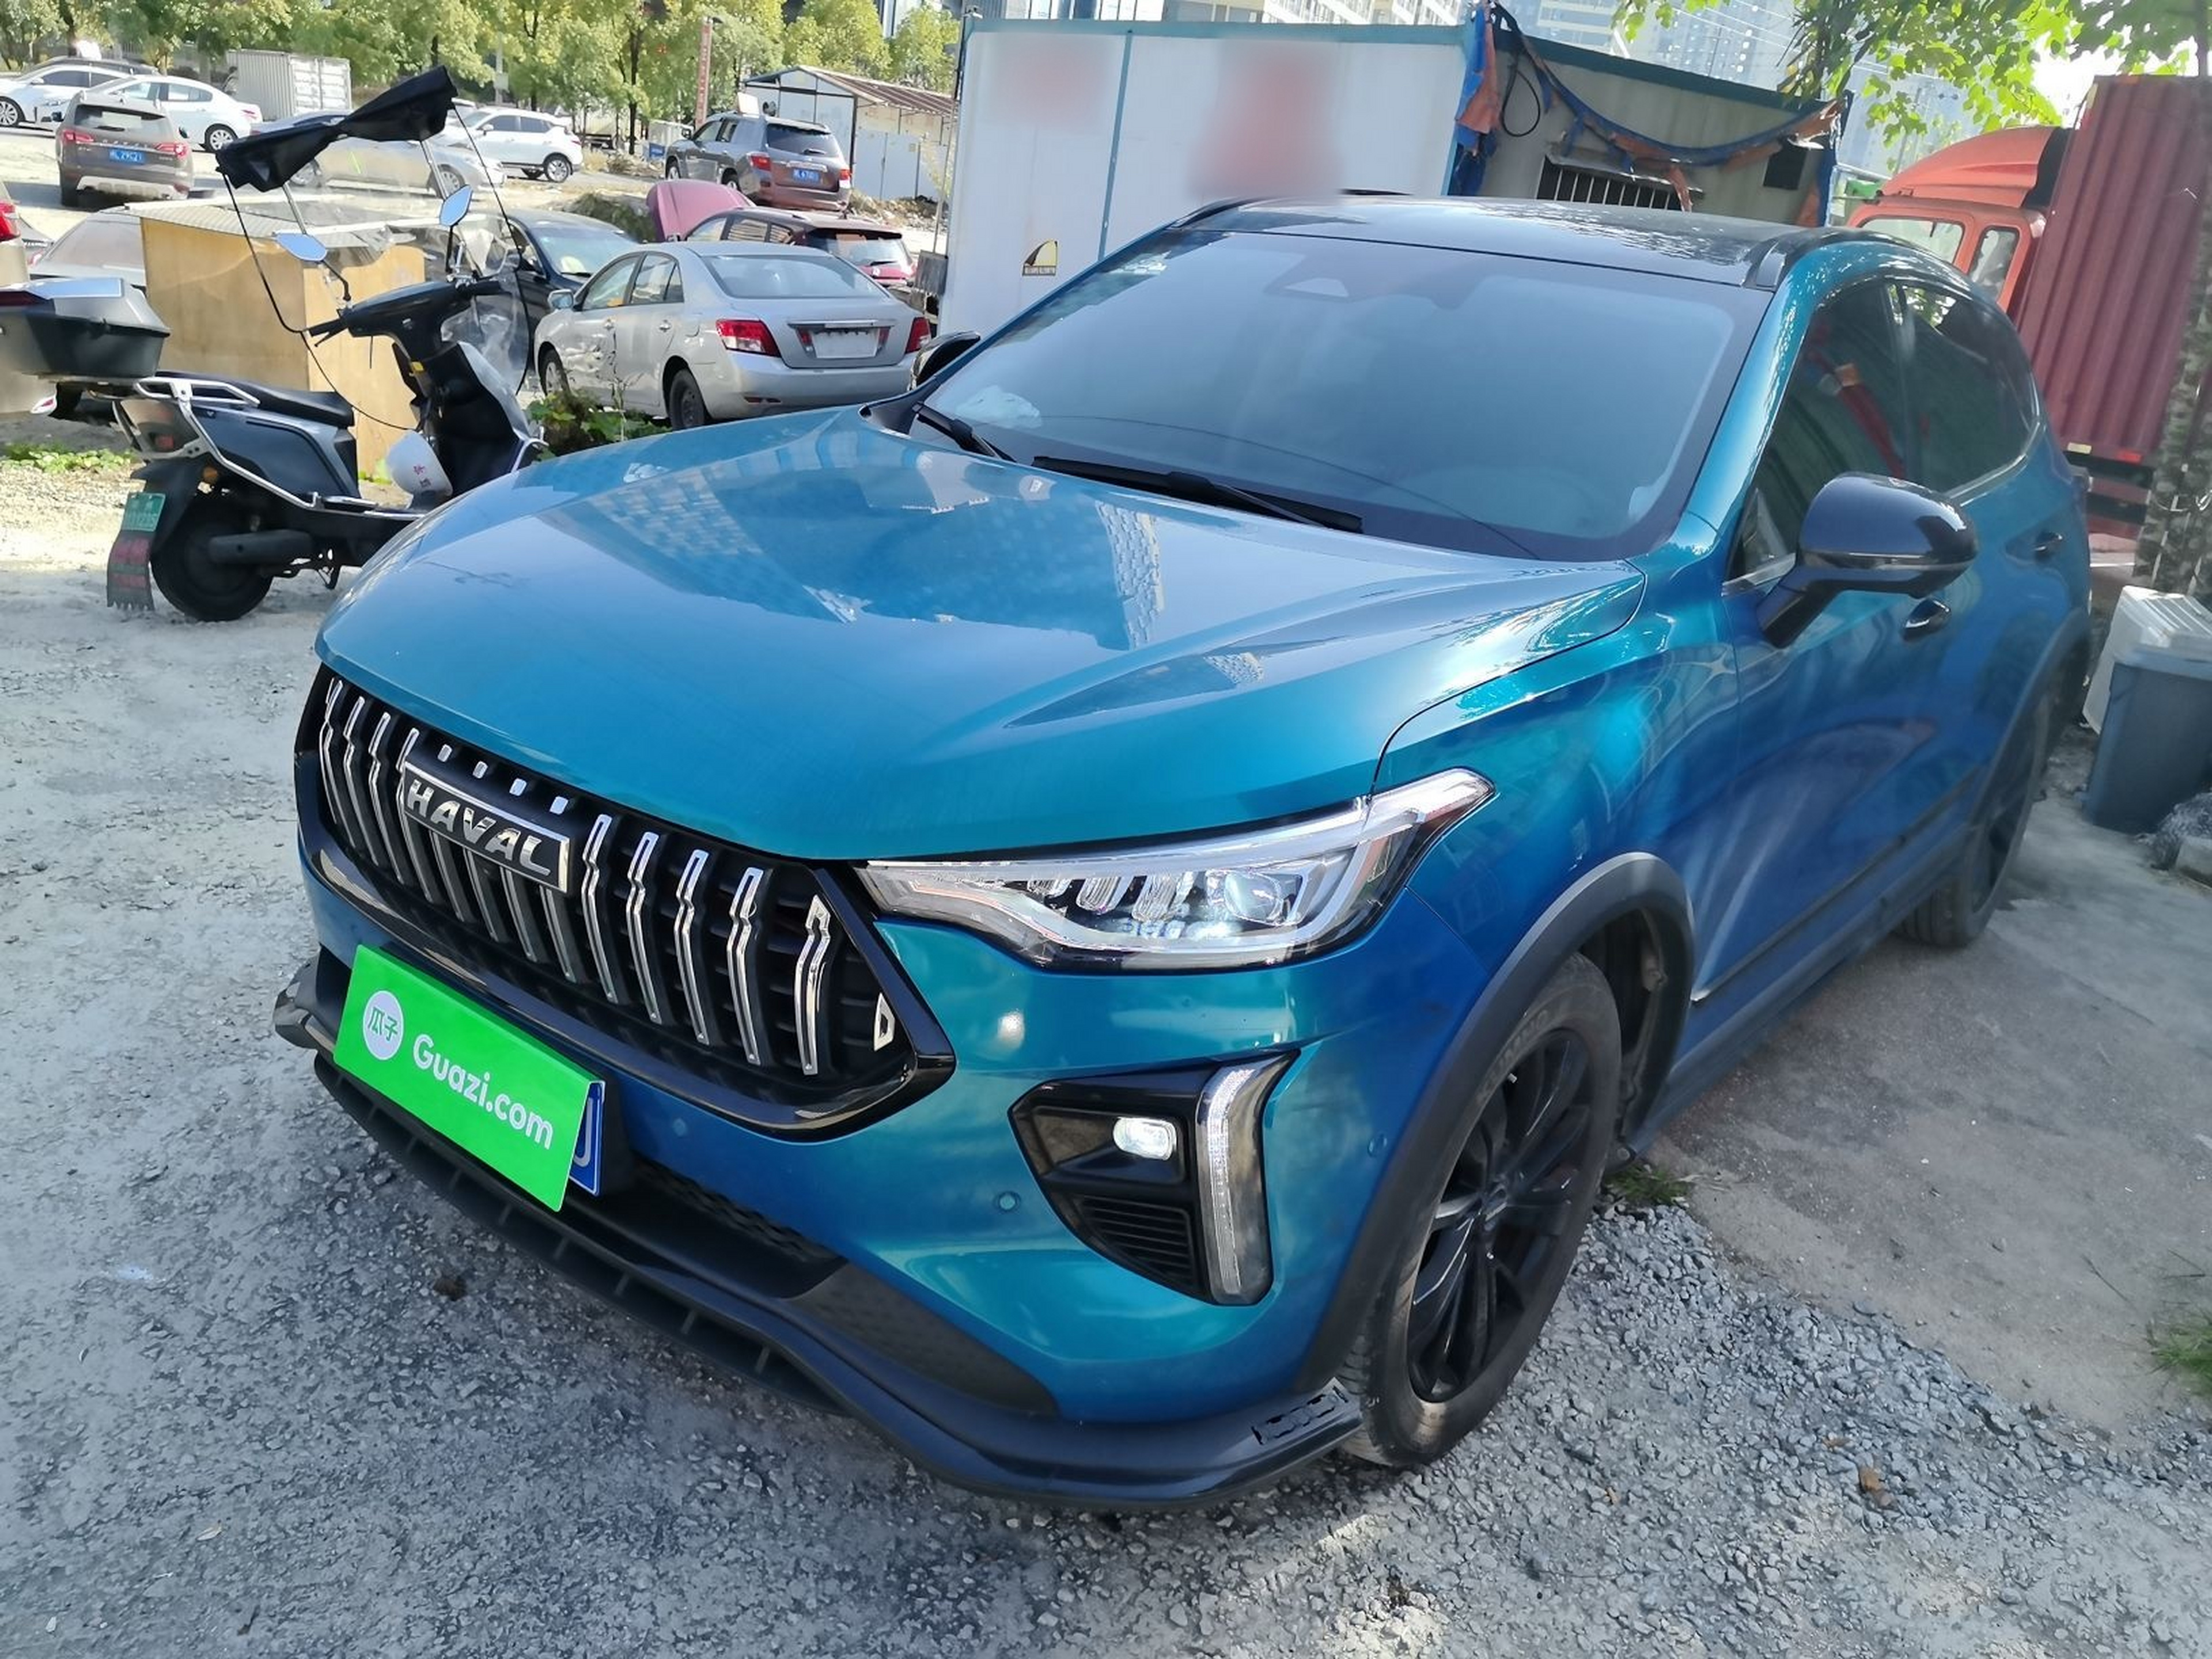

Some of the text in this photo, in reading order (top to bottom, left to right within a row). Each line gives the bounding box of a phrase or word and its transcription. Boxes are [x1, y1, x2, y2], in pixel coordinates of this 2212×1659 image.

[407, 779, 551, 876] HAVAL
[368, 1006, 397, 1041] 瓜子
[412, 1034, 554, 1150] Guazi.com
